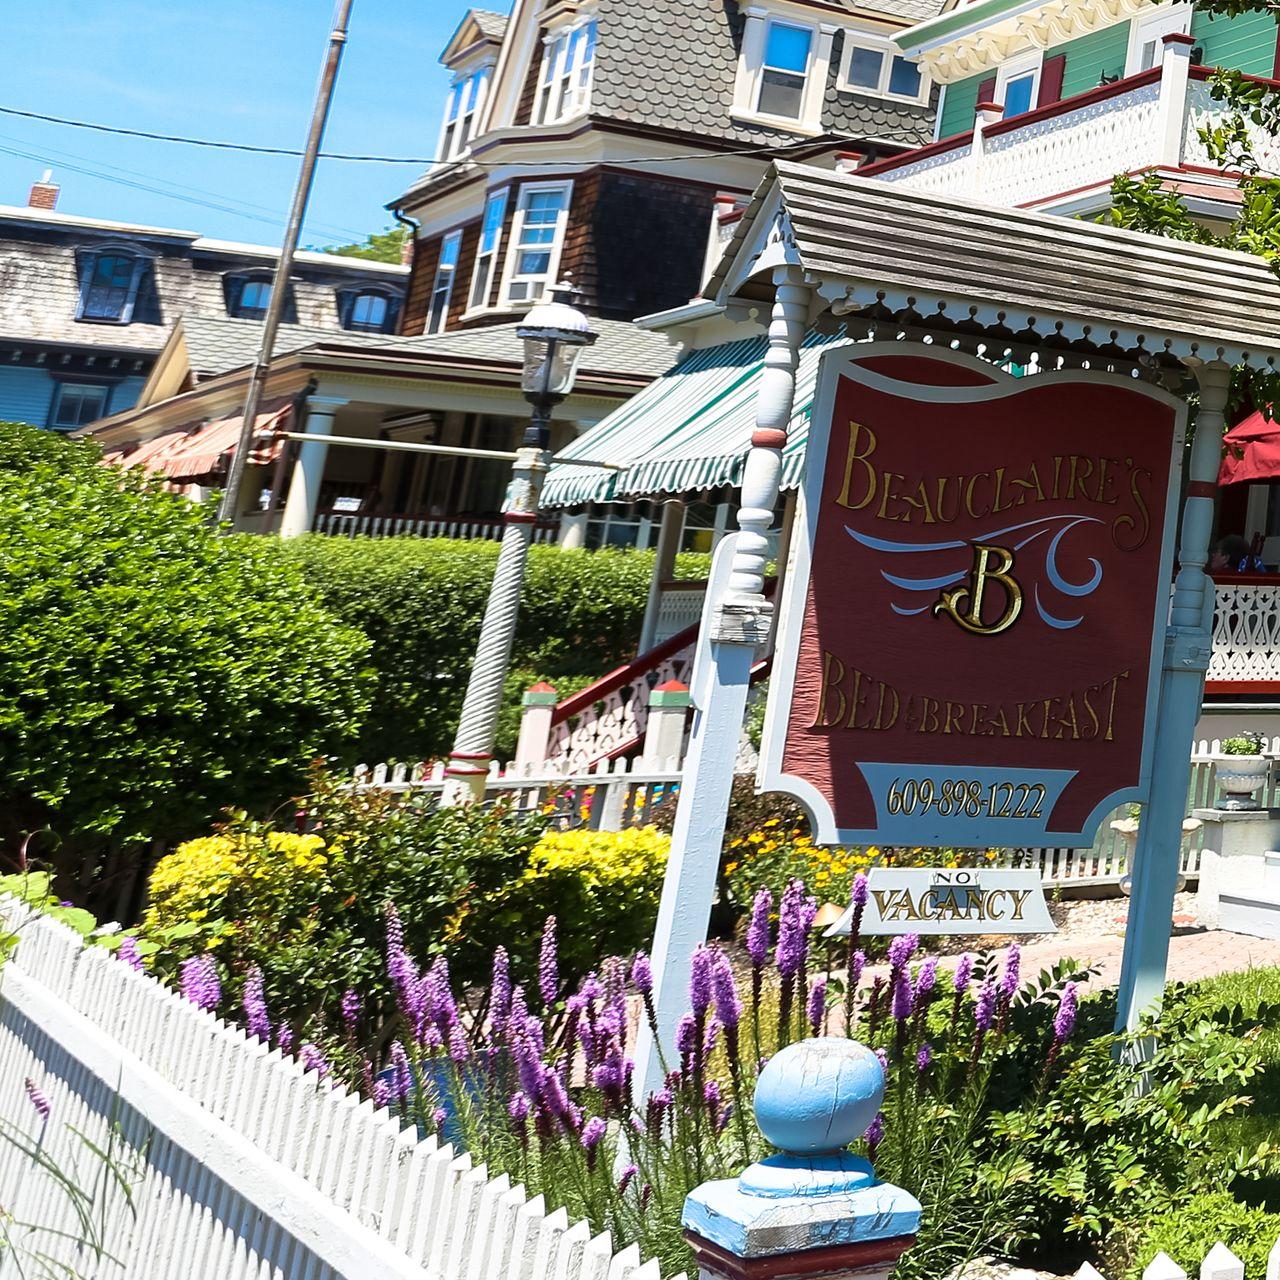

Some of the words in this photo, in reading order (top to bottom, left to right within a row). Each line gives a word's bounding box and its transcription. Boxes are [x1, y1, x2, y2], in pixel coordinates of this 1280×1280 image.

[835, 420, 1152, 551] BEAUCLAIRE'S
[815, 649, 900, 731] BED
[918, 669, 1131, 742] BREAKFAST
[887, 776, 1047, 819] 609-898-1222
[936, 872, 971, 884] NO
[871, 888, 1034, 922] VACANCY
